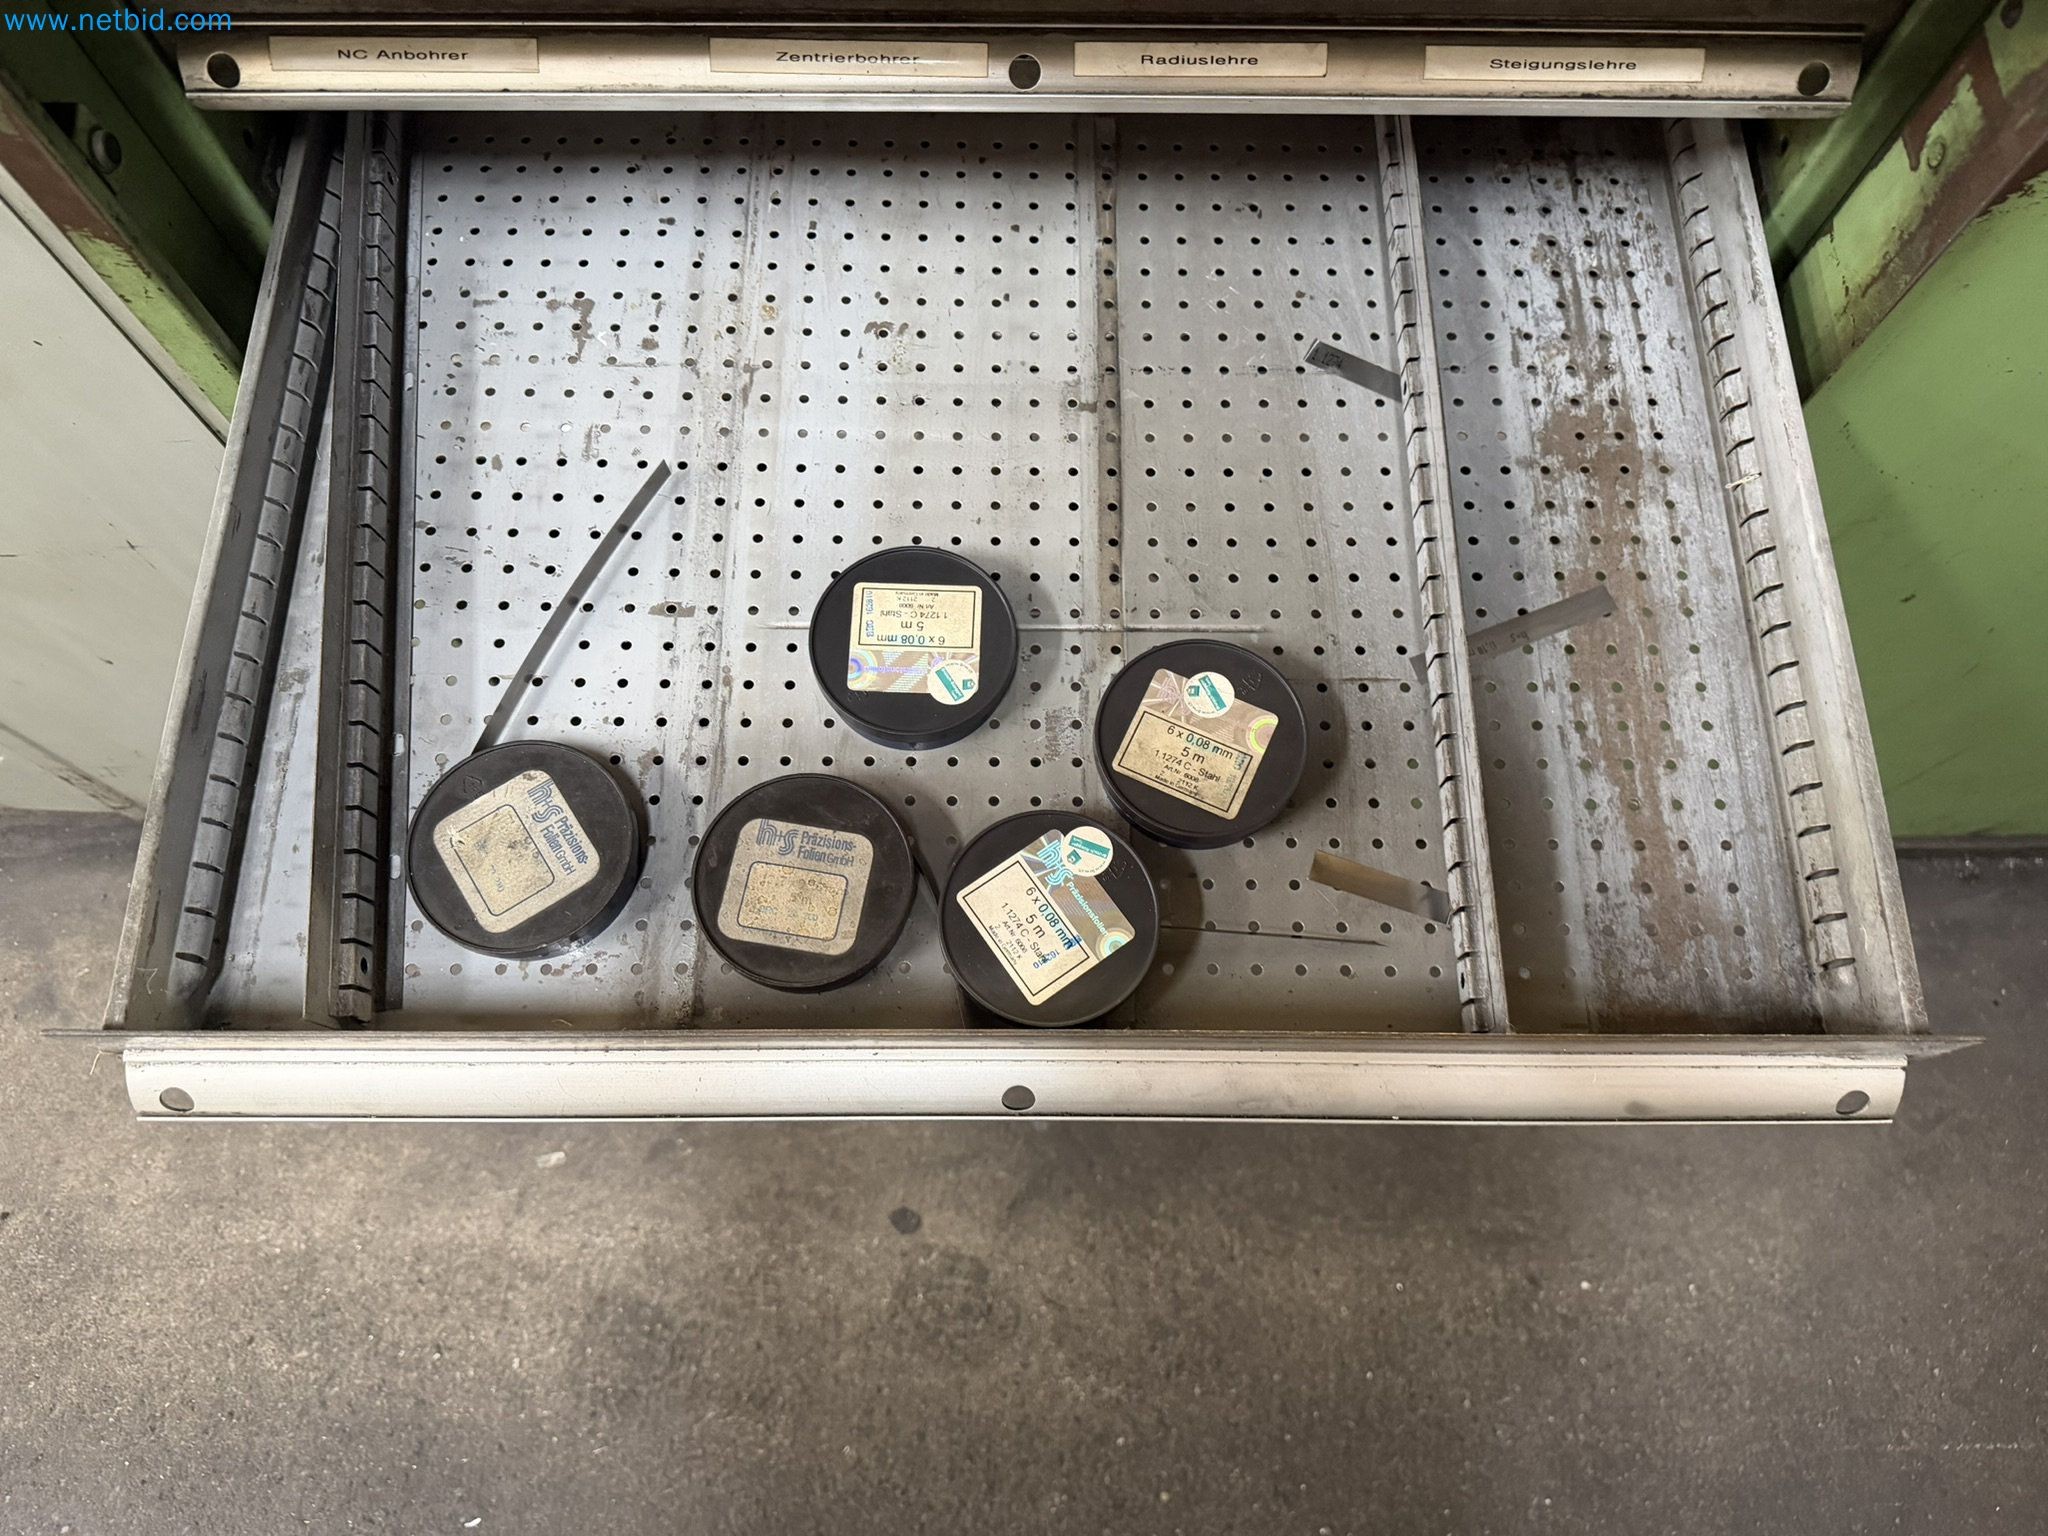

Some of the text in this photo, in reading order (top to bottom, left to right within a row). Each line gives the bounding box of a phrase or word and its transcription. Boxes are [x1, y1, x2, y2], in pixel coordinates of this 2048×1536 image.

[337, 49, 469, 60] NC Anbohrer
[775, 51, 921, 64] Zentrierbohrer
[1141, 55, 1259, 65] Radiuslehre
[1489, 59, 1637, 71] Steigungslehre
[901, 621, 924, 630] 5 m
[876, 634, 898, 643] mm
[938, 636, 945, 645] 6
[1167, 725, 1174, 735] 6
[1186, 734, 1210, 750] 0,08
[1212, 746, 1233, 759] mm
[1181, 747, 1205, 764] 5 m
[1155, 750, 1182, 766] 1.1274
[1183, 762, 1192, 770] C
[1199, 768, 1220, 782] Stahl
[556, 815, 589, 864] Präzisions-
[801, 831, 856, 851] Präzisions-
[541, 824, 576, 876] Folien GmbH
[797, 846, 854, 866] Folien GmbH
[1026, 887, 1034, 896] 6
[1032, 896, 1040, 904] x
[1038, 904, 1059, 928] 0,08
[1001, 902, 1023, 931] 1.1274
[1020, 929, 1030, 939] C
[1026, 915, 1045, 939] 5 m
